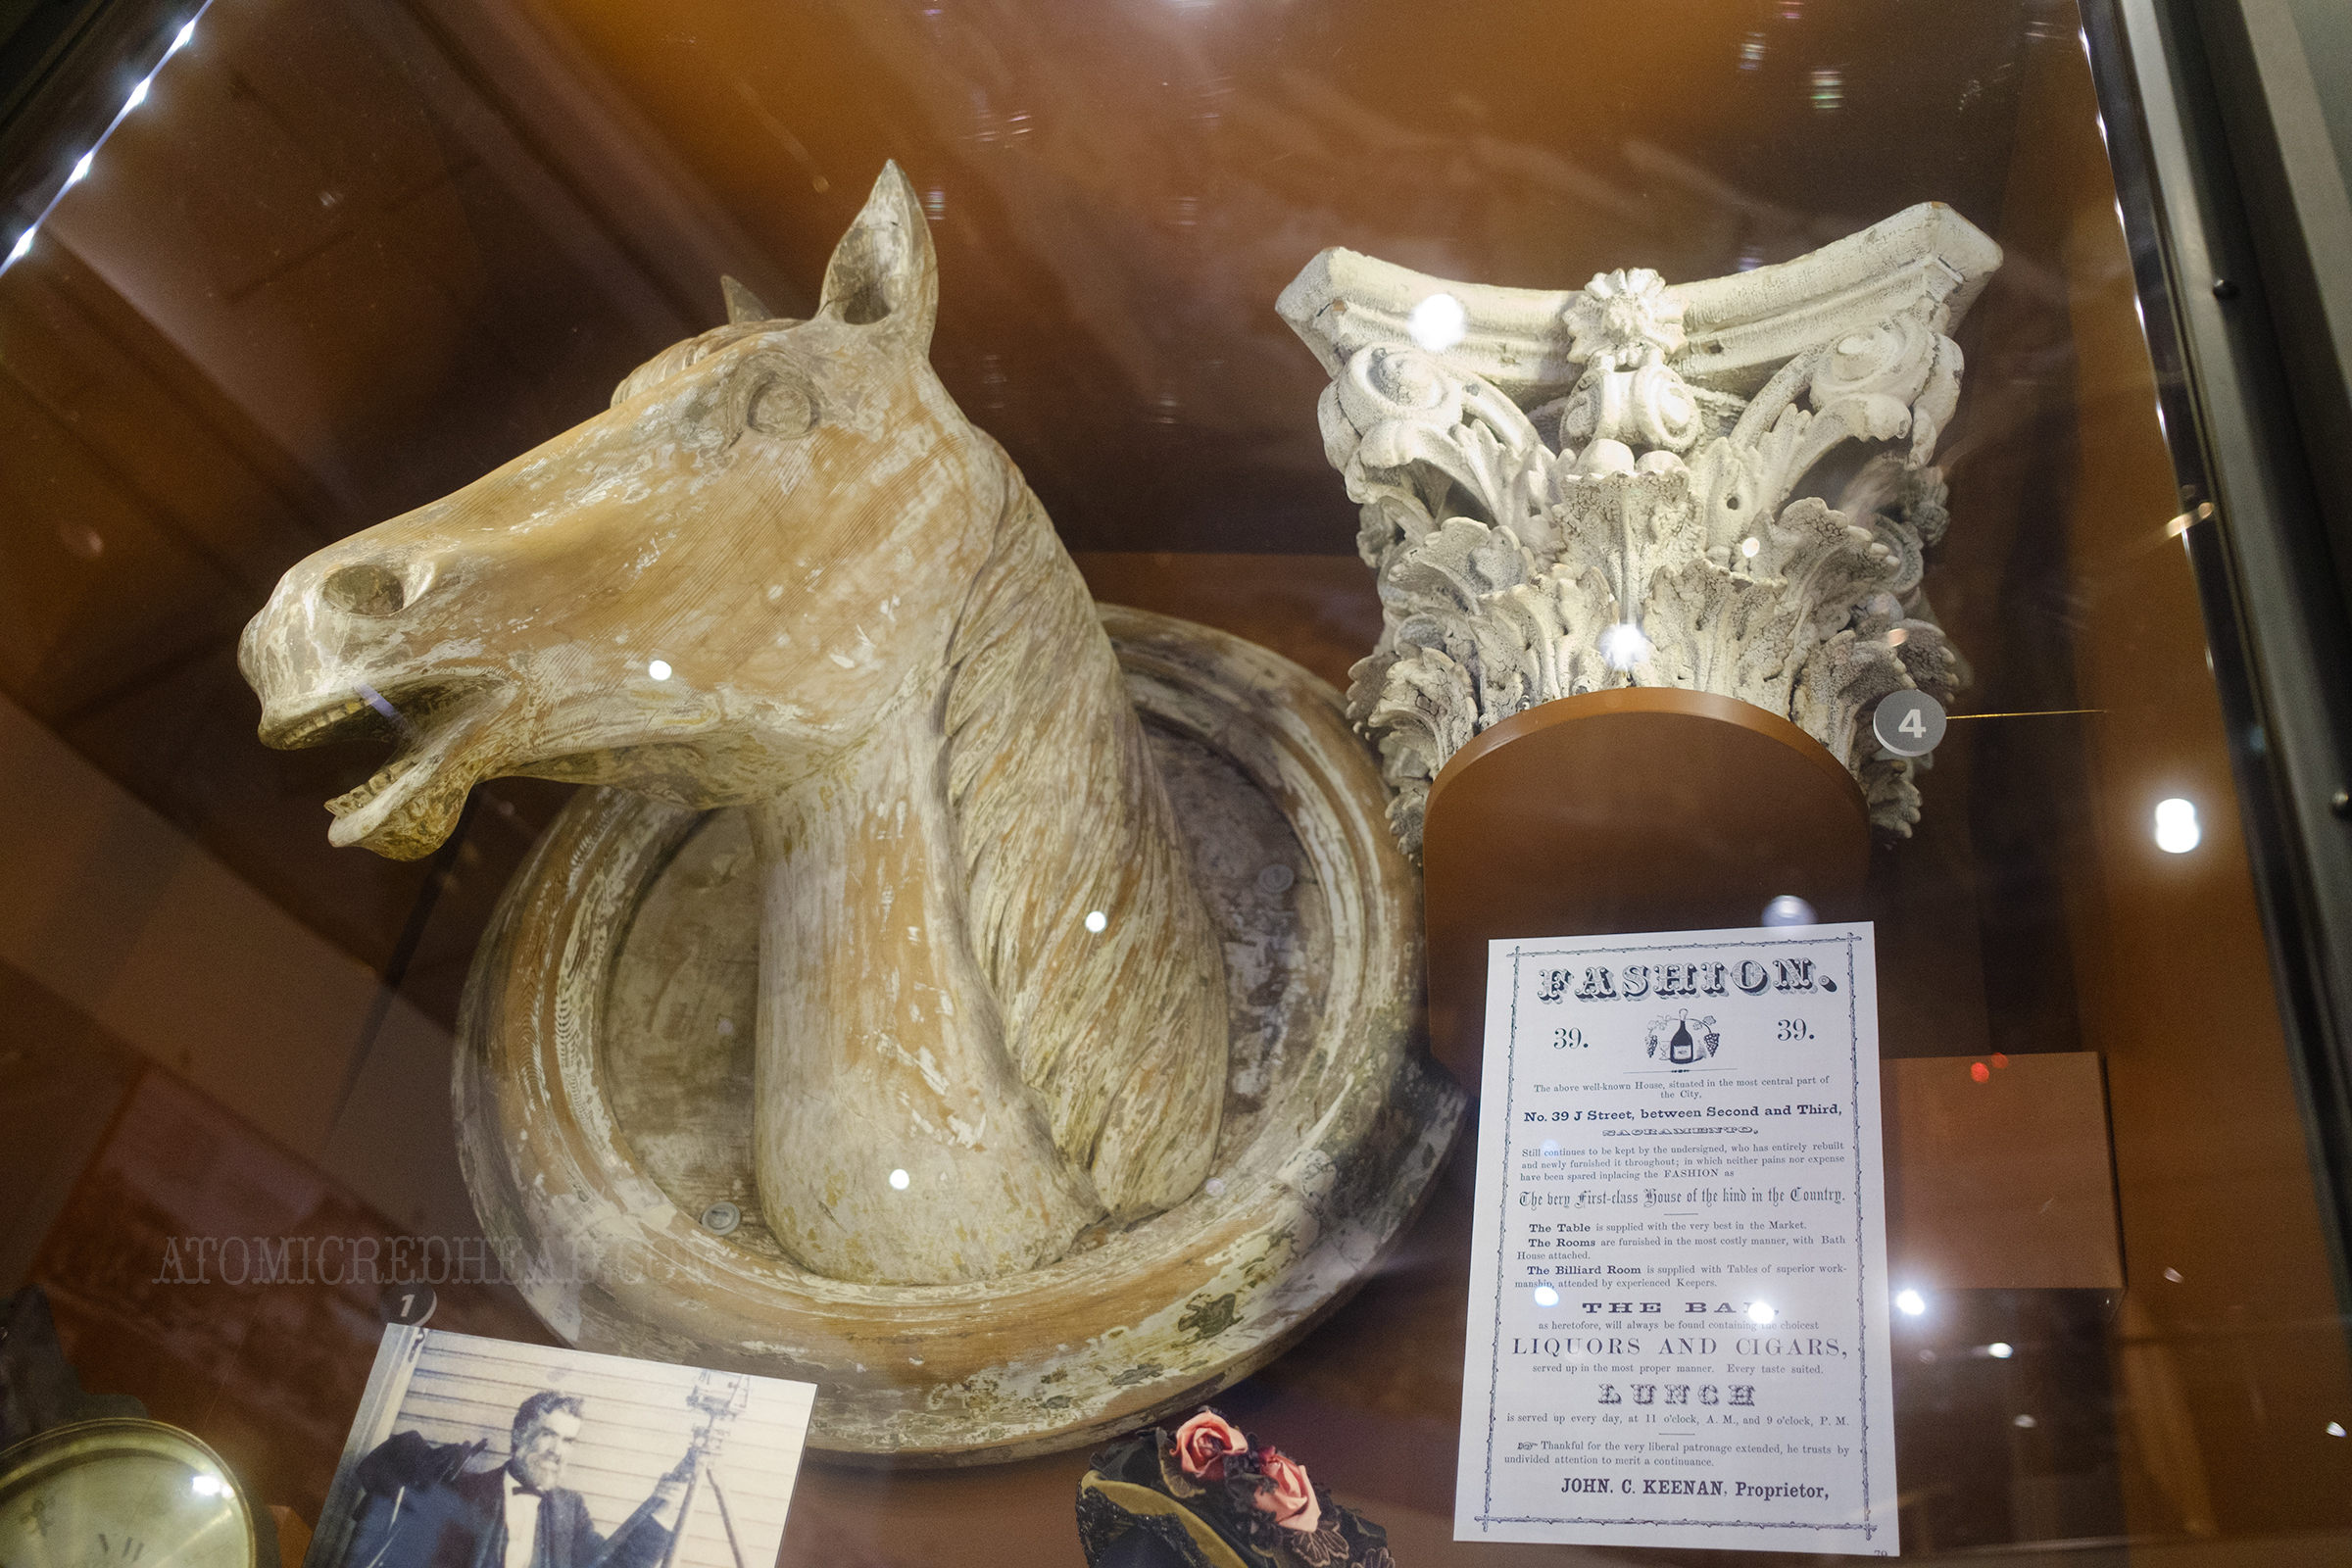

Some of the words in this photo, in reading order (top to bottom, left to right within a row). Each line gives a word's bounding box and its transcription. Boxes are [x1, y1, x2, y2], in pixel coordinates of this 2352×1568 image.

[1898, 710, 1927, 738] 4
[1538, 957, 1838, 1004] FASHION.
[1778, 1018, 1815, 1041] 39.
[1553, 1028, 1589, 1049] 39.
[1534, 1084, 1550, 1093] The
[1635, 1081, 1665, 1091] House,
[1669, 1079, 1704, 1088] situated
[1762, 1077, 1792, 1086] central
[1797, 1077, 1816, 1087] part
[1820, 1075, 1830, 1084] of
[1661, 1089, 1674, 1098] the
[1680, 1090, 1701, 1100] City,
[1524, 1112, 1547, 1121] No.
[1551, 1111, 1569, 1121] 39
[1574, 1111, 1583, 1121] J
[1588, 1110, 1635, 1120] Street,
[1641, 1109, 1701, 1118] between
[1706, 1106, 1759, 1117] Second
[1765, 1105, 1791, 1115] and
[1797, 1104, 1841, 1115] Third,
[1602, 1126, 1758, 1136] SACRAMENTO,
[1615, 1147, 1635, 1156] kept
[1639, 1147, 1649, 1156] by
[1671, 1145, 1727, 1154] undersigned,
[1772, 1143, 1807, 1152] entirely
[1541, 1160, 1566, 1170] newly
[1570, 1159, 1610, 1168] furnished
[1625, 1158, 1679, 1168] throughout;
[1696, 1156, 1723, 1165] which
[1762, 1155, 1786, 1166] pains
[1808, 1155, 1844, 1165] expense
[1567, 1171, 1596, 1182] spared
[1599, 1171, 1640, 1181] inplacing
[1519, 1191, 1543, 1210] The
[1574, 1190, 1638, 1208] First-class
[1643, 1188, 1682, 1207] House
[1687, 1188, 1697, 1202] of
[1702, 1187, 1718, 1207] the
[1723, 1187, 1746, 1202] kind
[1752, 1187, 1763, 1201] in
[1768, 1187, 1785, 1206] the
[1790, 1187, 1845, 1204] Country.
[1529, 1224, 1551, 1233] The
[1557, 1223, 1591, 1233] Table
[1606, 1222, 1643, 1233] supplied
[1647, 1222, 1667, 1231] with
[1690, 1223, 1709, 1232] very
[1713, 1221, 1732, 1230] best
[1749, 1221, 1764, 1230] the
[1768, 1221, 1807, 1230] Market.
[1529, 1239, 1551, 1248] The
[1556, 1238, 1596, 1247] Rooms
[1618, 1236, 1661, 1246] furnished
[1677, 1237, 1691, 1246] the
[1720, 1237, 1747, 1247] costly
[1792, 1236, 1814, 1245] with
[1821, 1235, 1846, 1245] Bath
[1527, 1266, 1550, 1275] The
[1555, 1265, 1601, 1275] Billiard
[1607, 1265, 1642, 1274] Room
[1657, 1265, 1695, 1276] supplied
[1727, 1264, 1758, 1273] Tables
[1761, 1264, 1772, 1273] of
[1776, 1264, 1815, 1275] superior
[1558, 1279, 1597, 1288] attended
[1601, 1279, 1614, 1290] by
[1616, 1278, 1671, 1289] experienced
[1677, 1278, 1717, 1289] Keepers.
[401, 1294, 416, 1318] 1
[1582, 1302, 1661, 1313] THE
[1551, 1321, 1601, 1331] heretofore,
[1627, 1321, 1659, 1331] always
[1678, 1320, 1705, 1329] found
[1708, 1321, 1758, 1332] containing
[1781, 1321, 1820, 1330] choicest
[1512, 1337, 1641, 1357] LIQUORS
[1658, 1338, 1717, 1354] AND
[1736, 1338, 1847, 1359] CIGARS,
[1533, 1363, 1562, 1372] served
[1565, 1365, 1578, 1374] up
[1593, 1363, 1608, 1372] the
[1640, 1365, 1671, 1374] proper
[1727, 1364, 1755, 1375] Every
[1791, 1365, 1824, 1374] suited.
[1597, 1384, 1755, 1407] LUNCH
[1518, 1413, 1547, 1422] served
[1553, 1415, 1565, 1424] up
[1571, 1415, 1596, 1425] every
[1602, 1413, 1622, 1425] day,
[1706, 1415, 1718, 1424] A.
[1723, 1415, 1739, 1425] M.,
[1820, 1416, 1831, 1425] P.
[1836, 1416, 1849, 1426] M.
[1541, 1441, 1584, 1449] Thankful
[1605, 1442, 1620, 1450] the
[1624, 1445, 1644, 1453] very
[1683, 1444, 1732, 1454] patronage
[1736, 1444, 1783, 1455] extended,
[1788, 1444, 1798, 1453] he
[1838, 1446, 1849, 1456] by
[1504, 1454, 1549, 1464] undivided
[1555, 1455, 1597, 1464] attention
[1615, 1456, 1641, 1465] merit
[1654, 1457, 1714, 1466] continuance.
[1561, 1478, 1613, 1493] JOHN.
[1622, 1479, 1635, 1494] C.
[1736, 1481, 1829, 1501] Proprietor,
